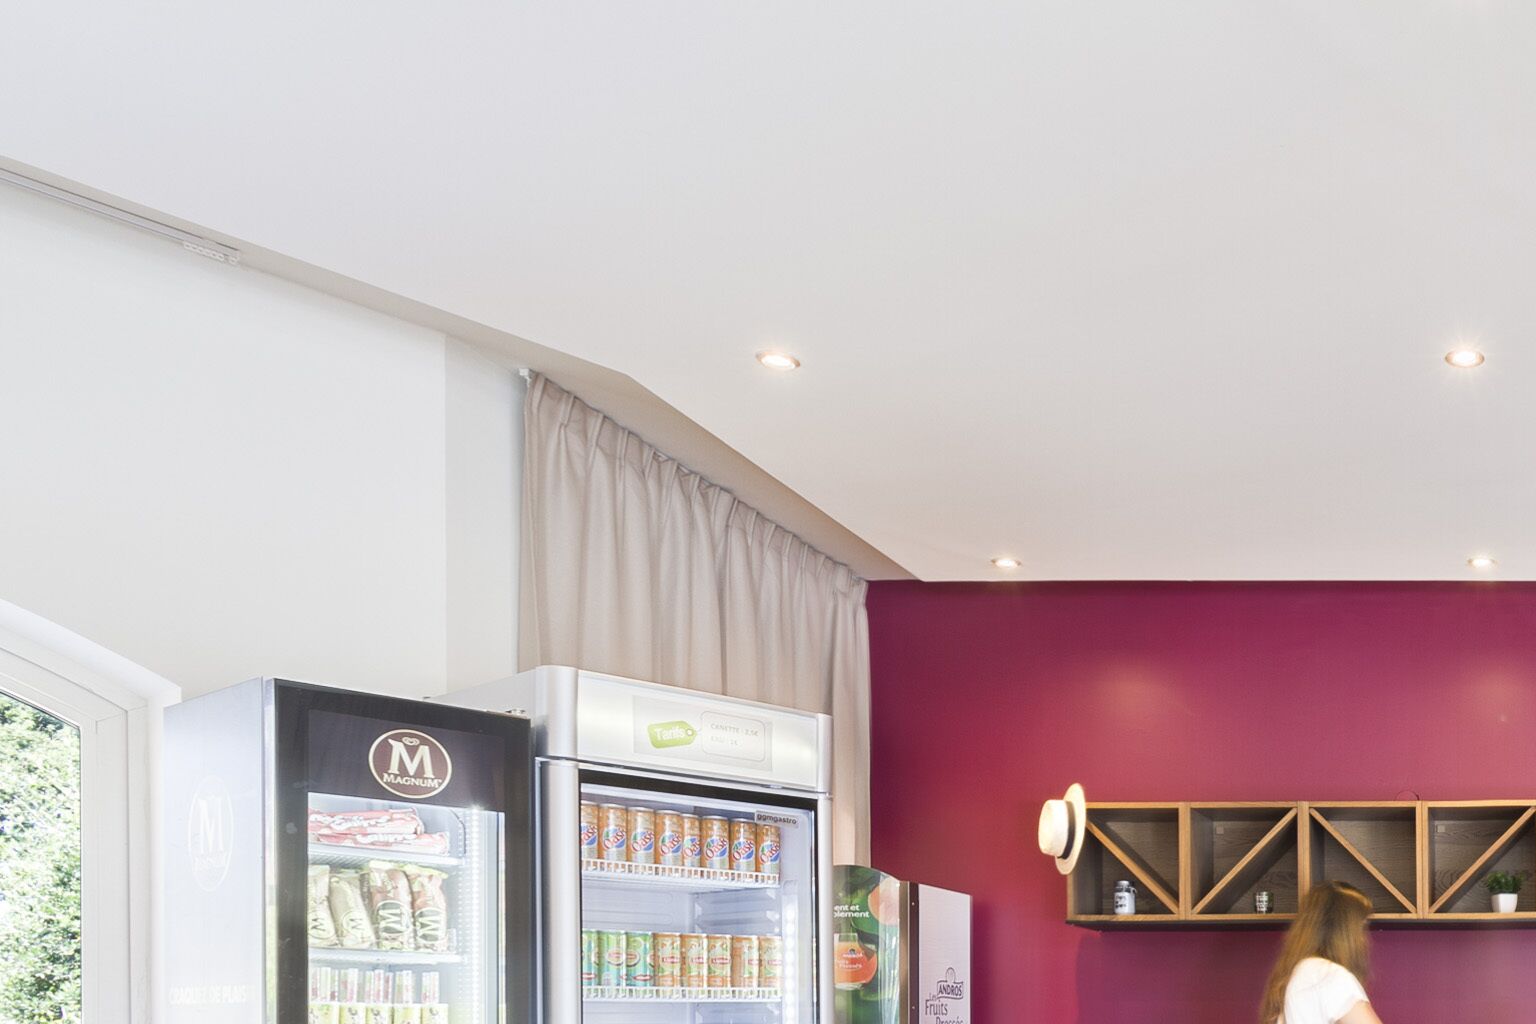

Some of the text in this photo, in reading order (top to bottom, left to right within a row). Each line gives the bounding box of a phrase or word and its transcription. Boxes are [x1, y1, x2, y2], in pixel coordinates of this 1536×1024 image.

[654, 725, 685, 740] Tarifs
[387, 738, 435, 779] M
[383, 773, 440, 789] MAGNUM
[939, 983, 962, 997] ANDROS
[925, 999, 948, 1016] Fruits
